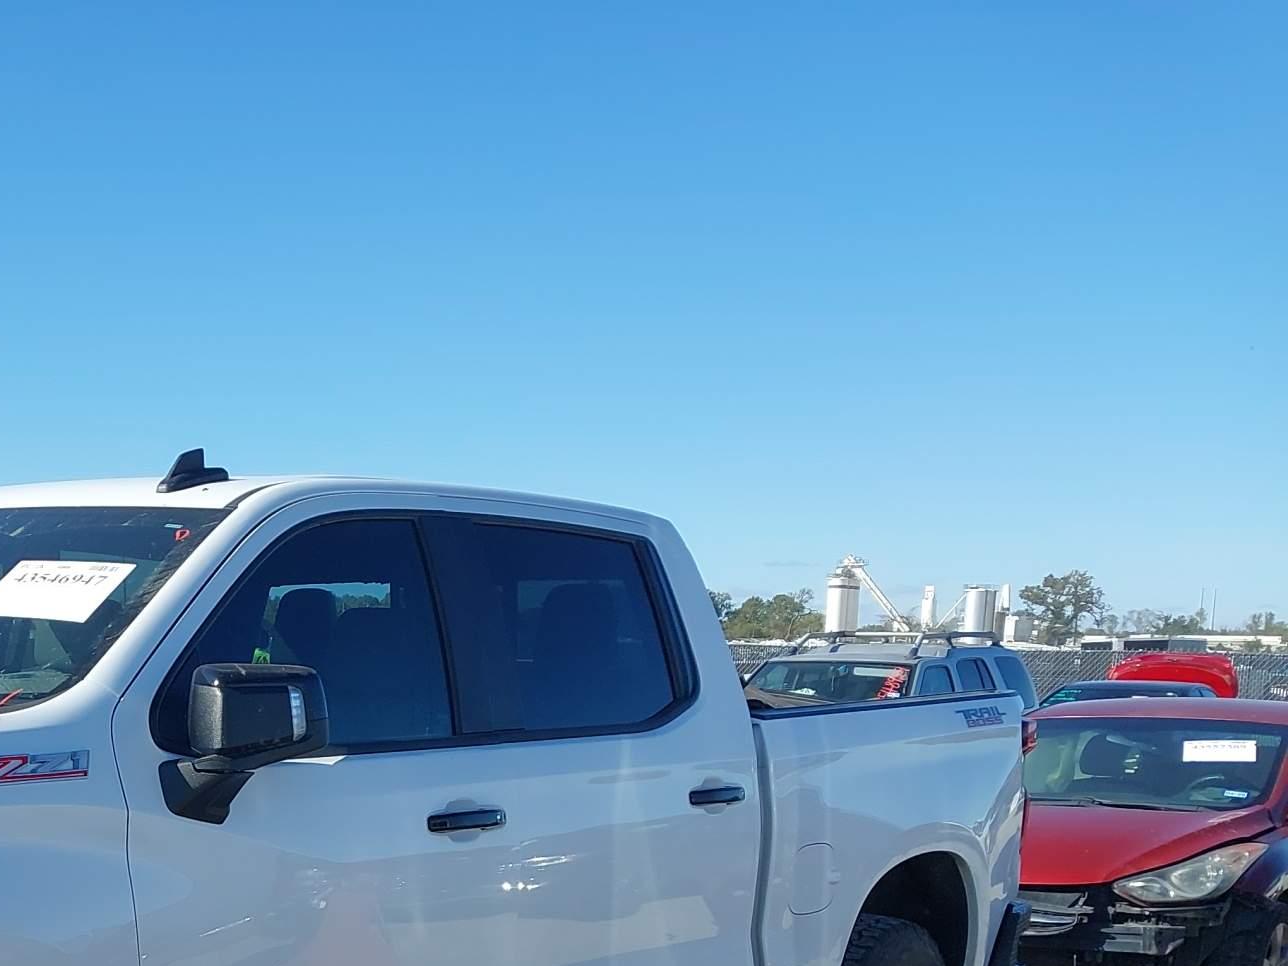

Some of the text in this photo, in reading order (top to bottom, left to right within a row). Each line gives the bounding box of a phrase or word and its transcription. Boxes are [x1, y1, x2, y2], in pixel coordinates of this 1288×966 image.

[14, 573, 108, 586] 43546947
[955, 705, 1006, 720] TRAIL
[967, 716, 1004, 728] BOSS
